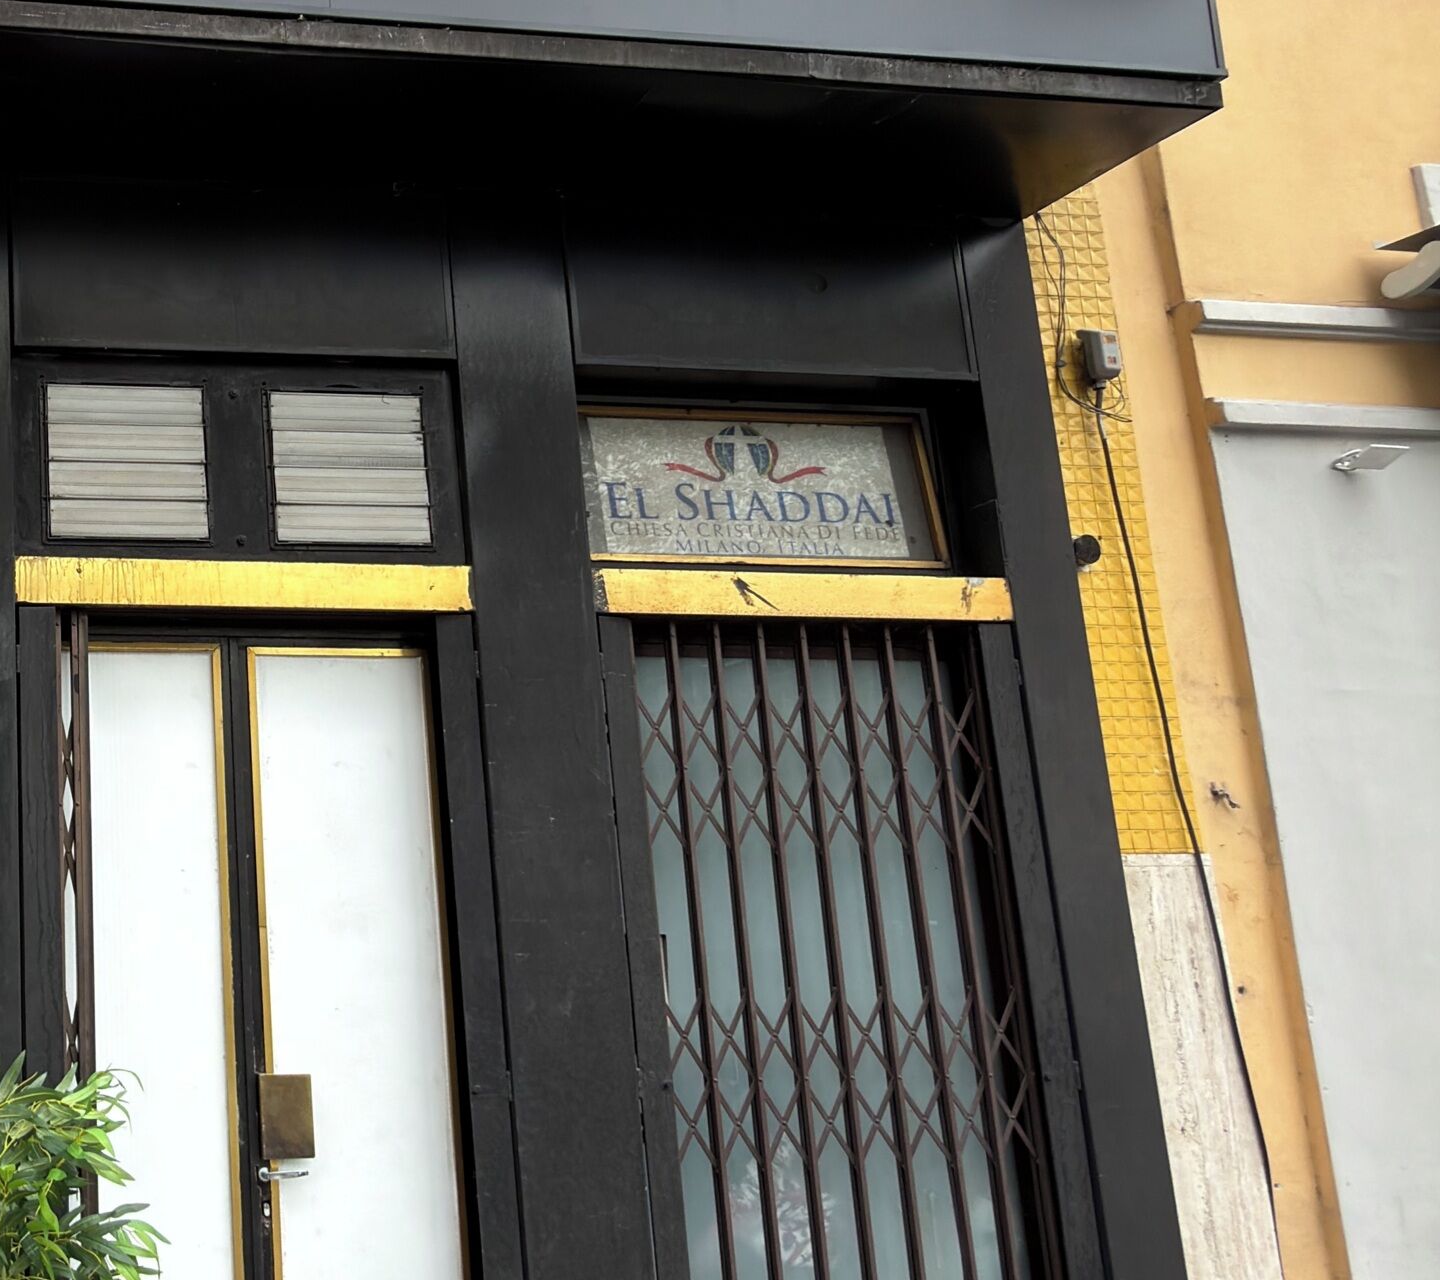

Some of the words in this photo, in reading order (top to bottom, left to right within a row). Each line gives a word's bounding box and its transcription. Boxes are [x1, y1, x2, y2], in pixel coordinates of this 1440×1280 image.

[674, 483, 900, 525] SHADDAI
[611, 520, 688, 537] CHIESA
[697, 521, 808, 539] CRISTIANA
[817, 524, 841, 539] DI
[852, 526, 901, 541] FEDE
[776, 539, 845, 555] ITALIA
